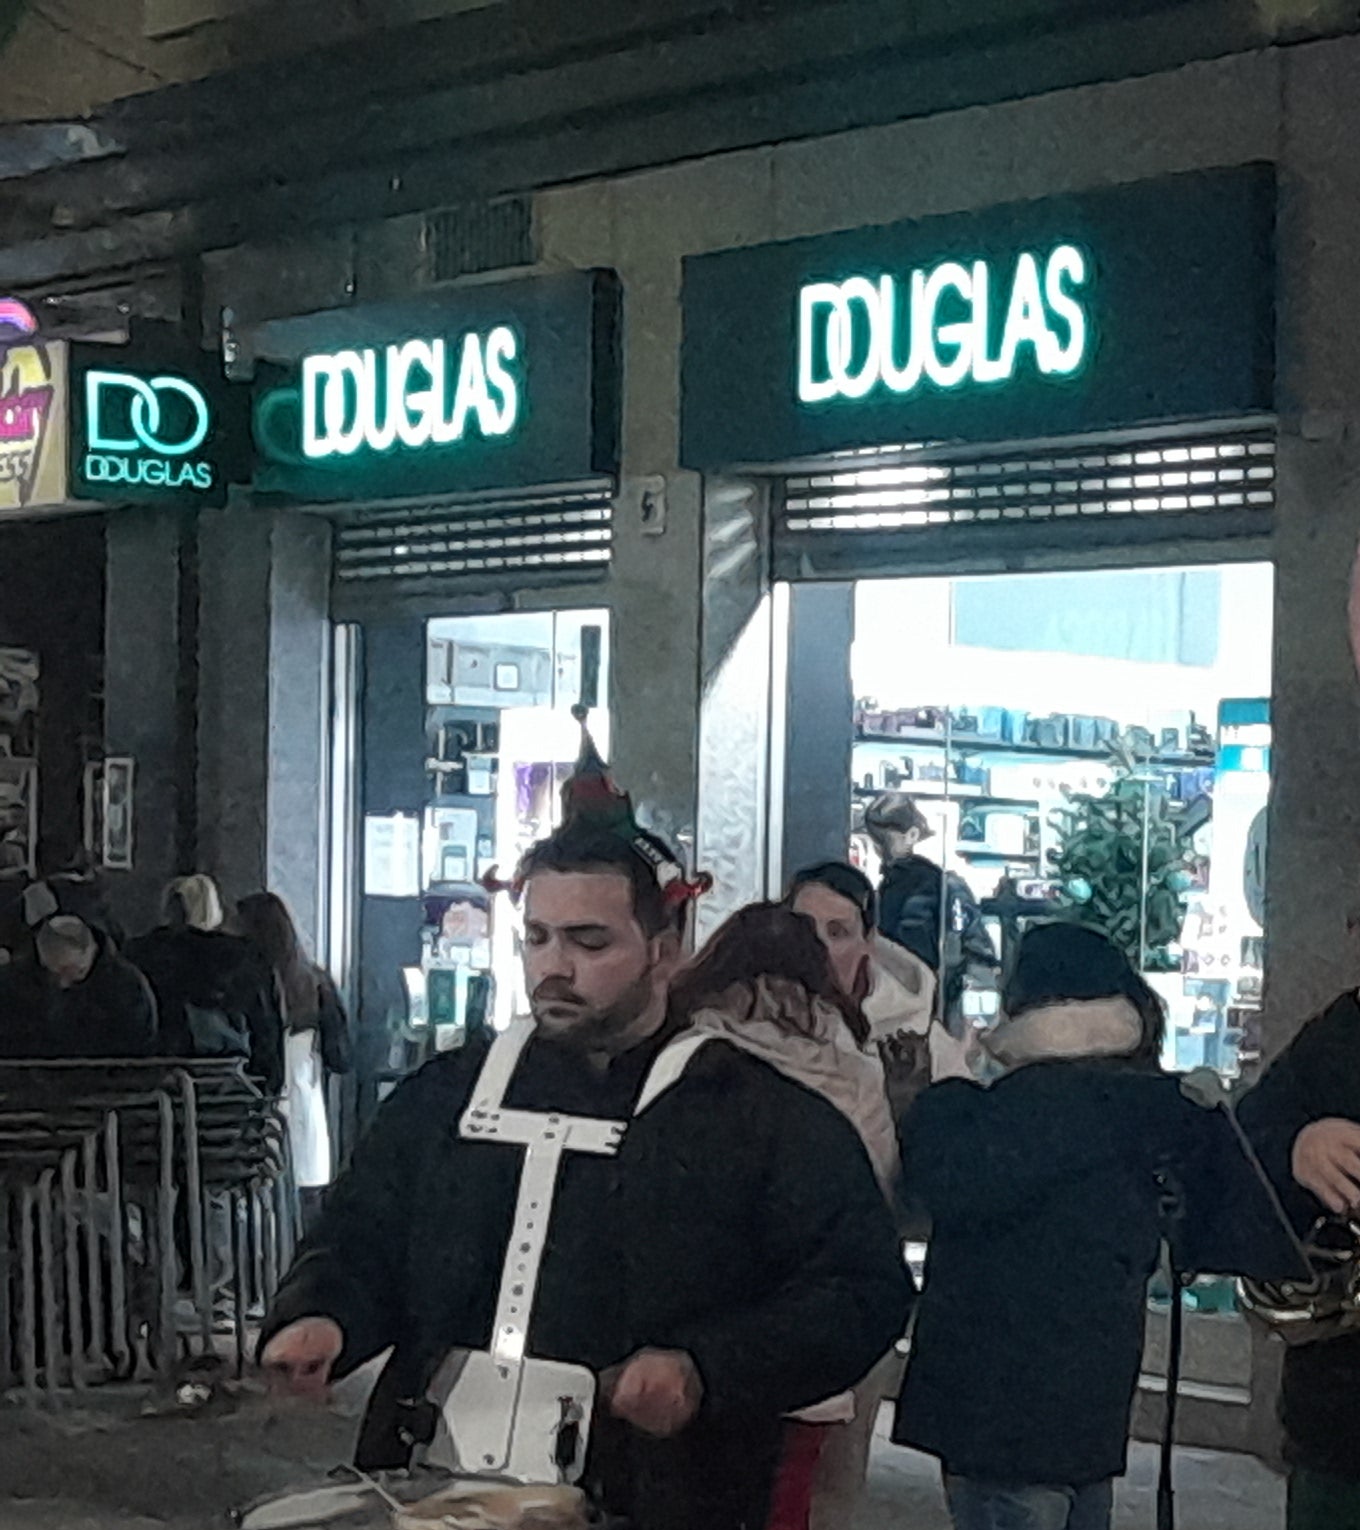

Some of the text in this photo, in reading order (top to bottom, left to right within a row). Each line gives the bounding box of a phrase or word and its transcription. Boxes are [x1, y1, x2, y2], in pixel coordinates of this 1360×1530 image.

[798, 244, 1087, 403] DOUGLAS
[302, 326, 518, 459] DOUGLAS
[86, 454, 212, 489] DOUGLAS
